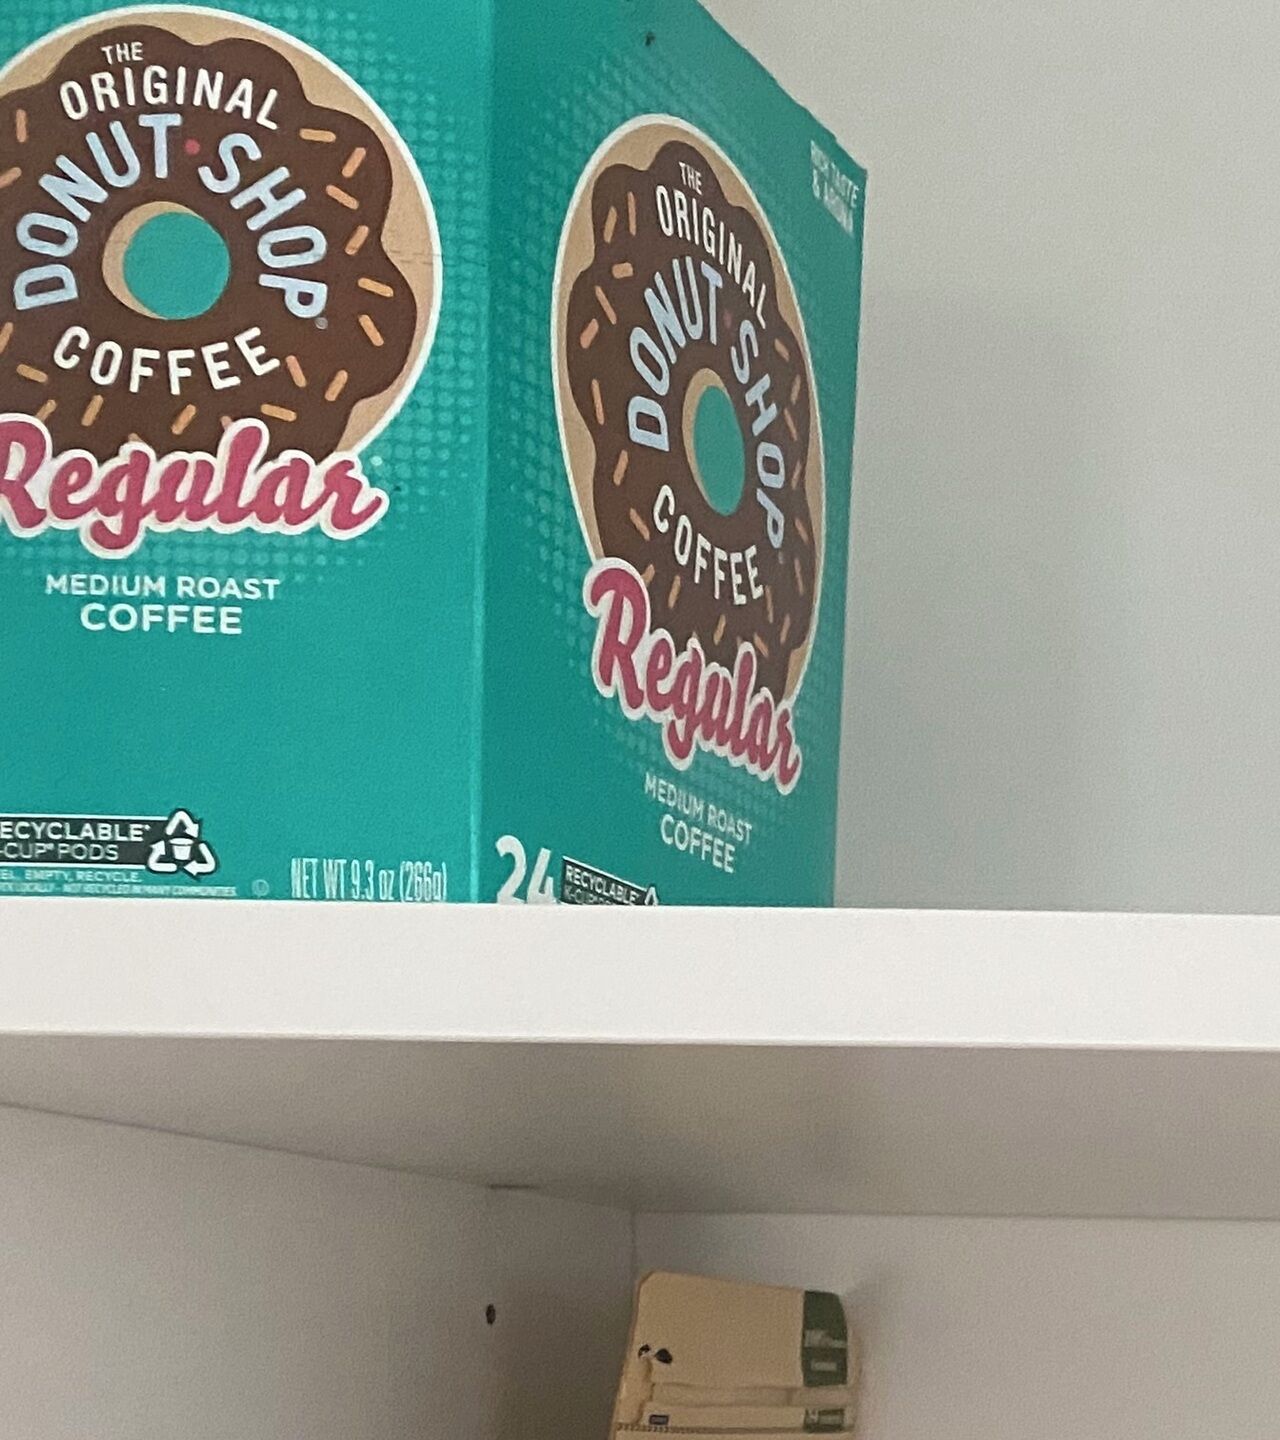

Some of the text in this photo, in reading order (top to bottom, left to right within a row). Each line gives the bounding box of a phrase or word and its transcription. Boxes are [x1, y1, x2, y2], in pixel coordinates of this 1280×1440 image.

[101, 41, 144, 65] THE
[60, 65, 280, 132] ORIGINAL
[679, 161, 703, 195] THE
[13, 112, 328, 318] DONUT SHOP
[656, 185, 767, 329] ORIGINAL
[53, 325, 281, 396] COFFEE
[627, 254, 786, 549] DONUT SHOP
[653, 484, 764, 605] COFFEE
[45, 574, 281, 601] MEDIUM ROAST
[80, 603, 244, 635] COFFEE
[585, 560, 801, 792] Regular
[645, 773, 752, 845] MEDIUM ROAST
[58, 843, 119, 861] PODS
[495, 834, 557, 904] 24
[660, 815, 735, 873] COFFEE
[291, 858, 318, 898] NET
[323, 859, 347, 899] WT
[351, 859, 374, 899] 9.3
[378, 869, 395, 900] oz
